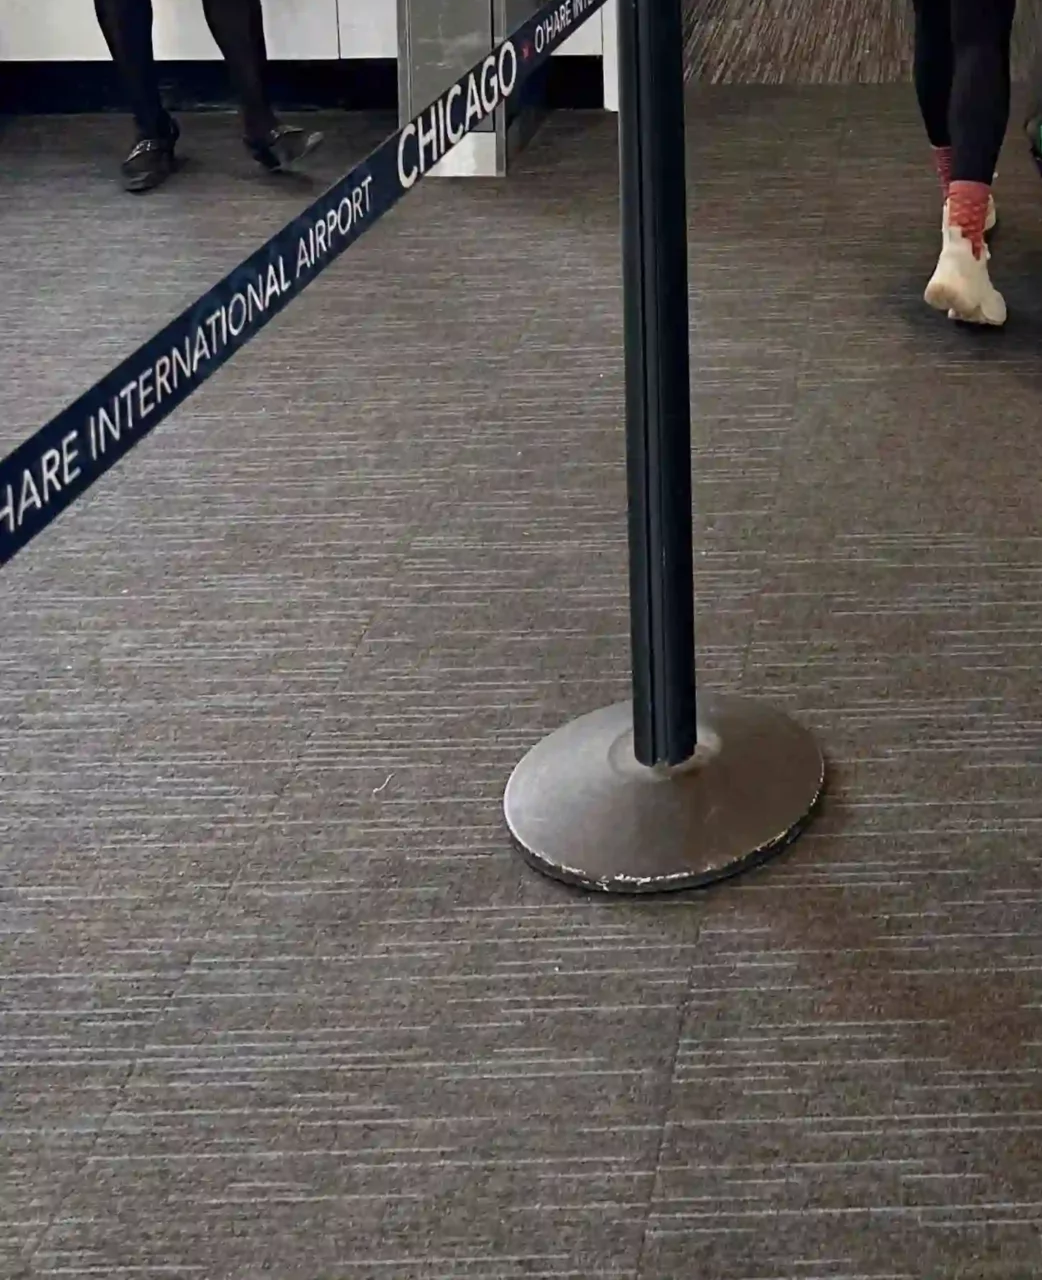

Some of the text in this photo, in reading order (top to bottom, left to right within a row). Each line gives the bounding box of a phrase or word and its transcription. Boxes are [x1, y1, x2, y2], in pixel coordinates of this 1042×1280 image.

[89, 255, 292, 462] INTERNATIONAL
[296, 175, 373, 279] AIRPORT
[398, 40, 518, 190] CHICAGO
[534, 0, 572, 54] O'HARE
